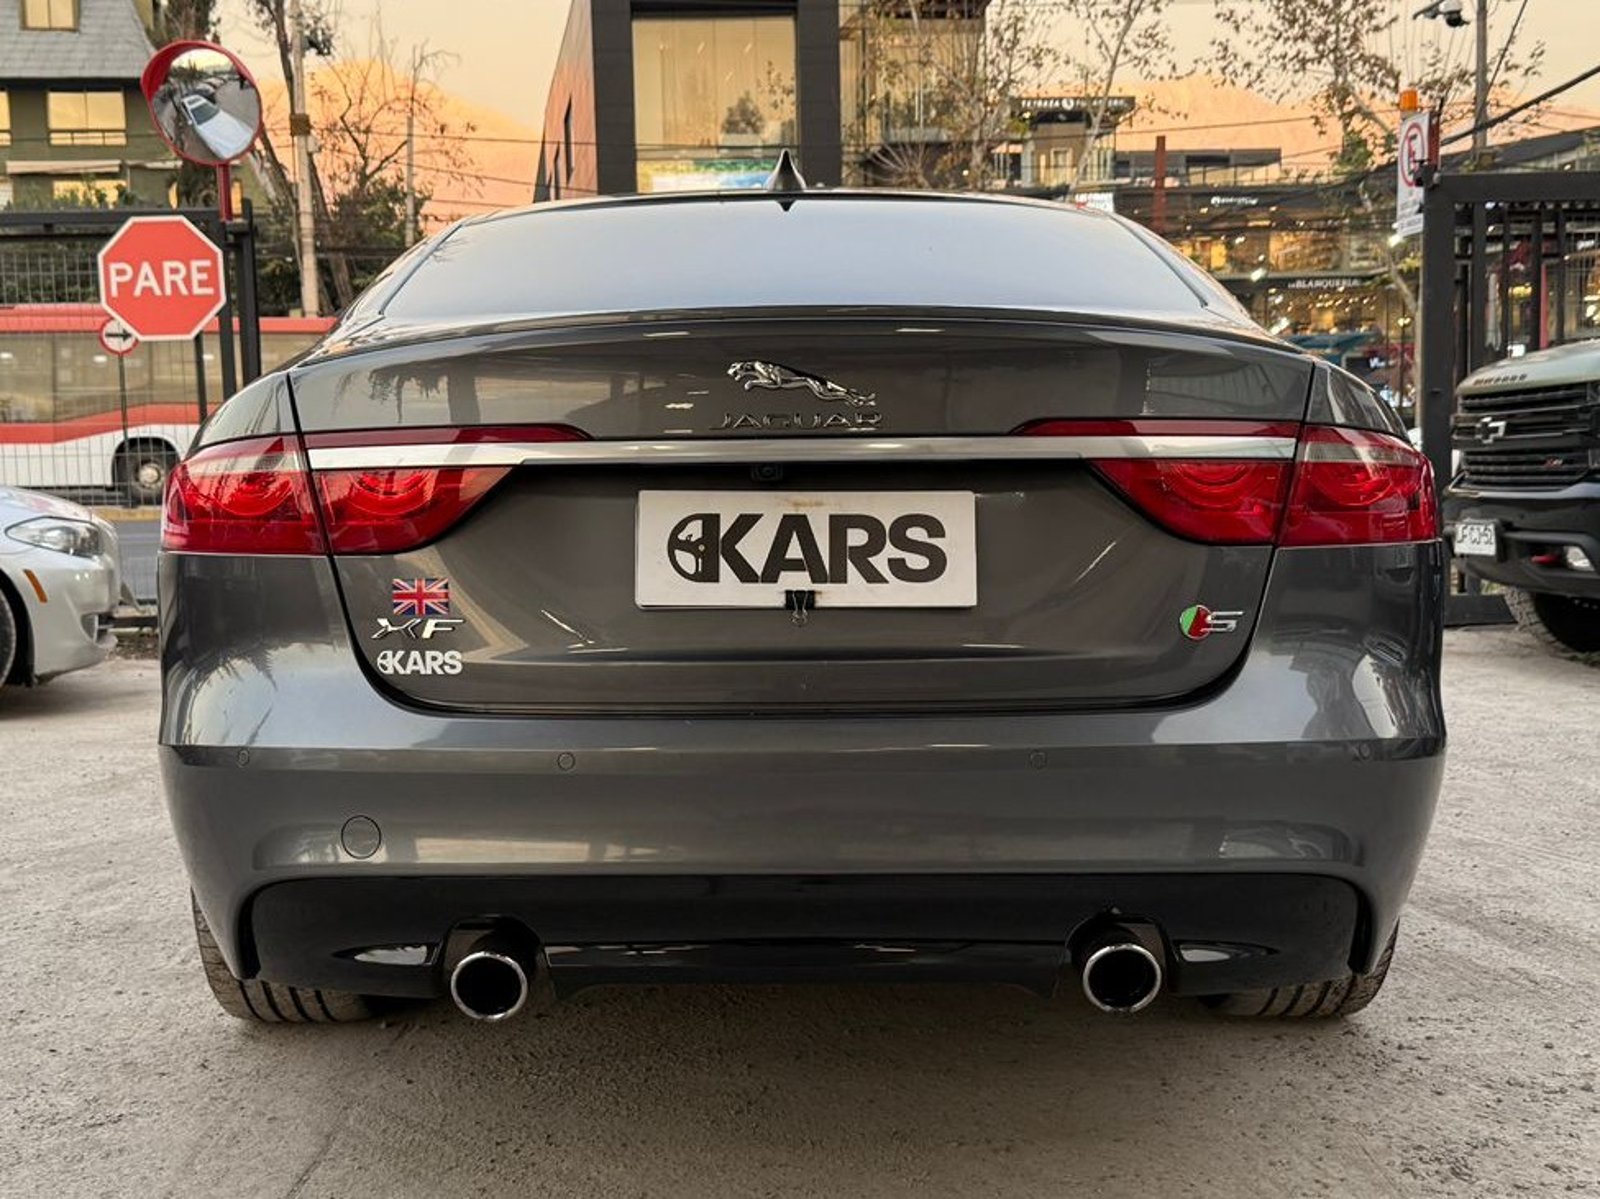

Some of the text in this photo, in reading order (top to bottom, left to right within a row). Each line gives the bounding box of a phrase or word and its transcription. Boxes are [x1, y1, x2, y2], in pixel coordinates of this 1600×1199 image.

[108, 259, 214, 298] PARE
[709, 412, 883, 431] JAGUAR
[700, 512, 948, 585] KARS
[370, 617, 465, 639] XF
[386, 649, 463, 675] KARS
